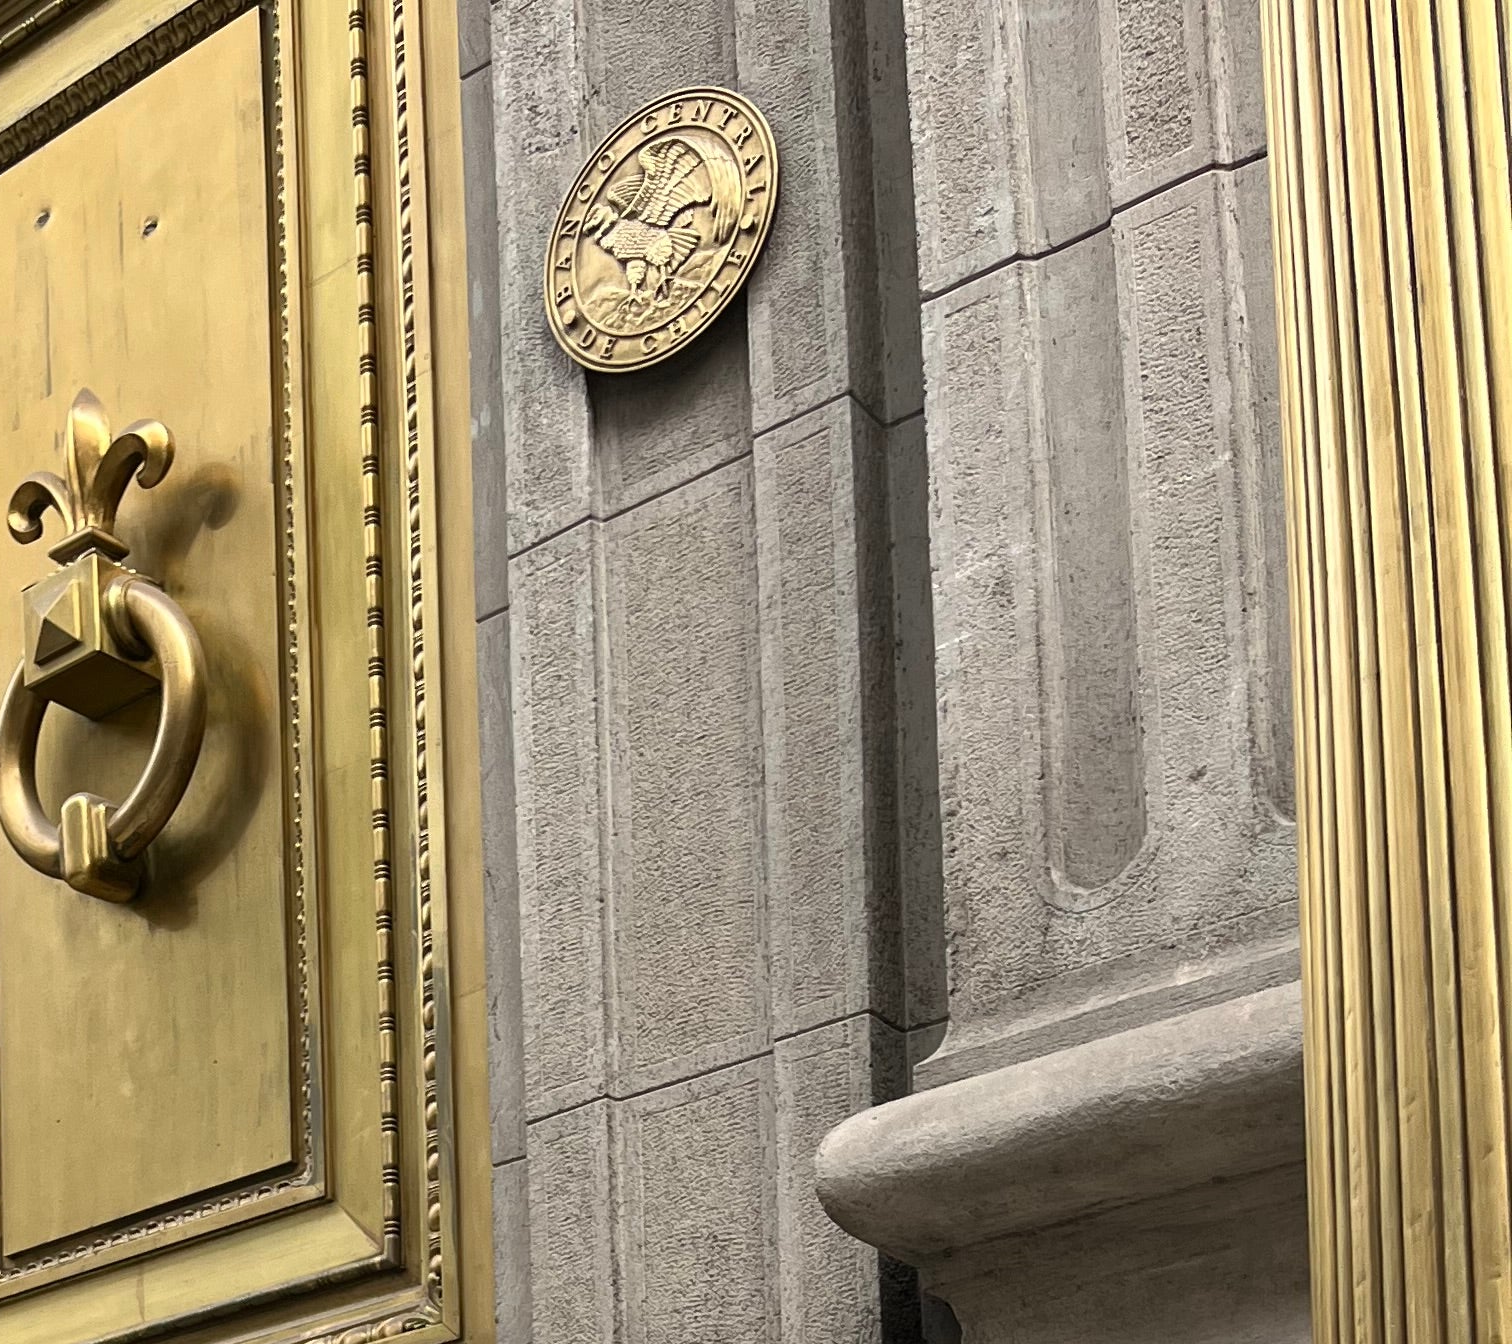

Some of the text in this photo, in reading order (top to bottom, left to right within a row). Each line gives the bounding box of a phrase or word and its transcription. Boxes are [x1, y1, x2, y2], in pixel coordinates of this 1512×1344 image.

[555, 98, 767, 306] BANCO CENTRAL
[577, 250, 748, 360] DE CHILE
